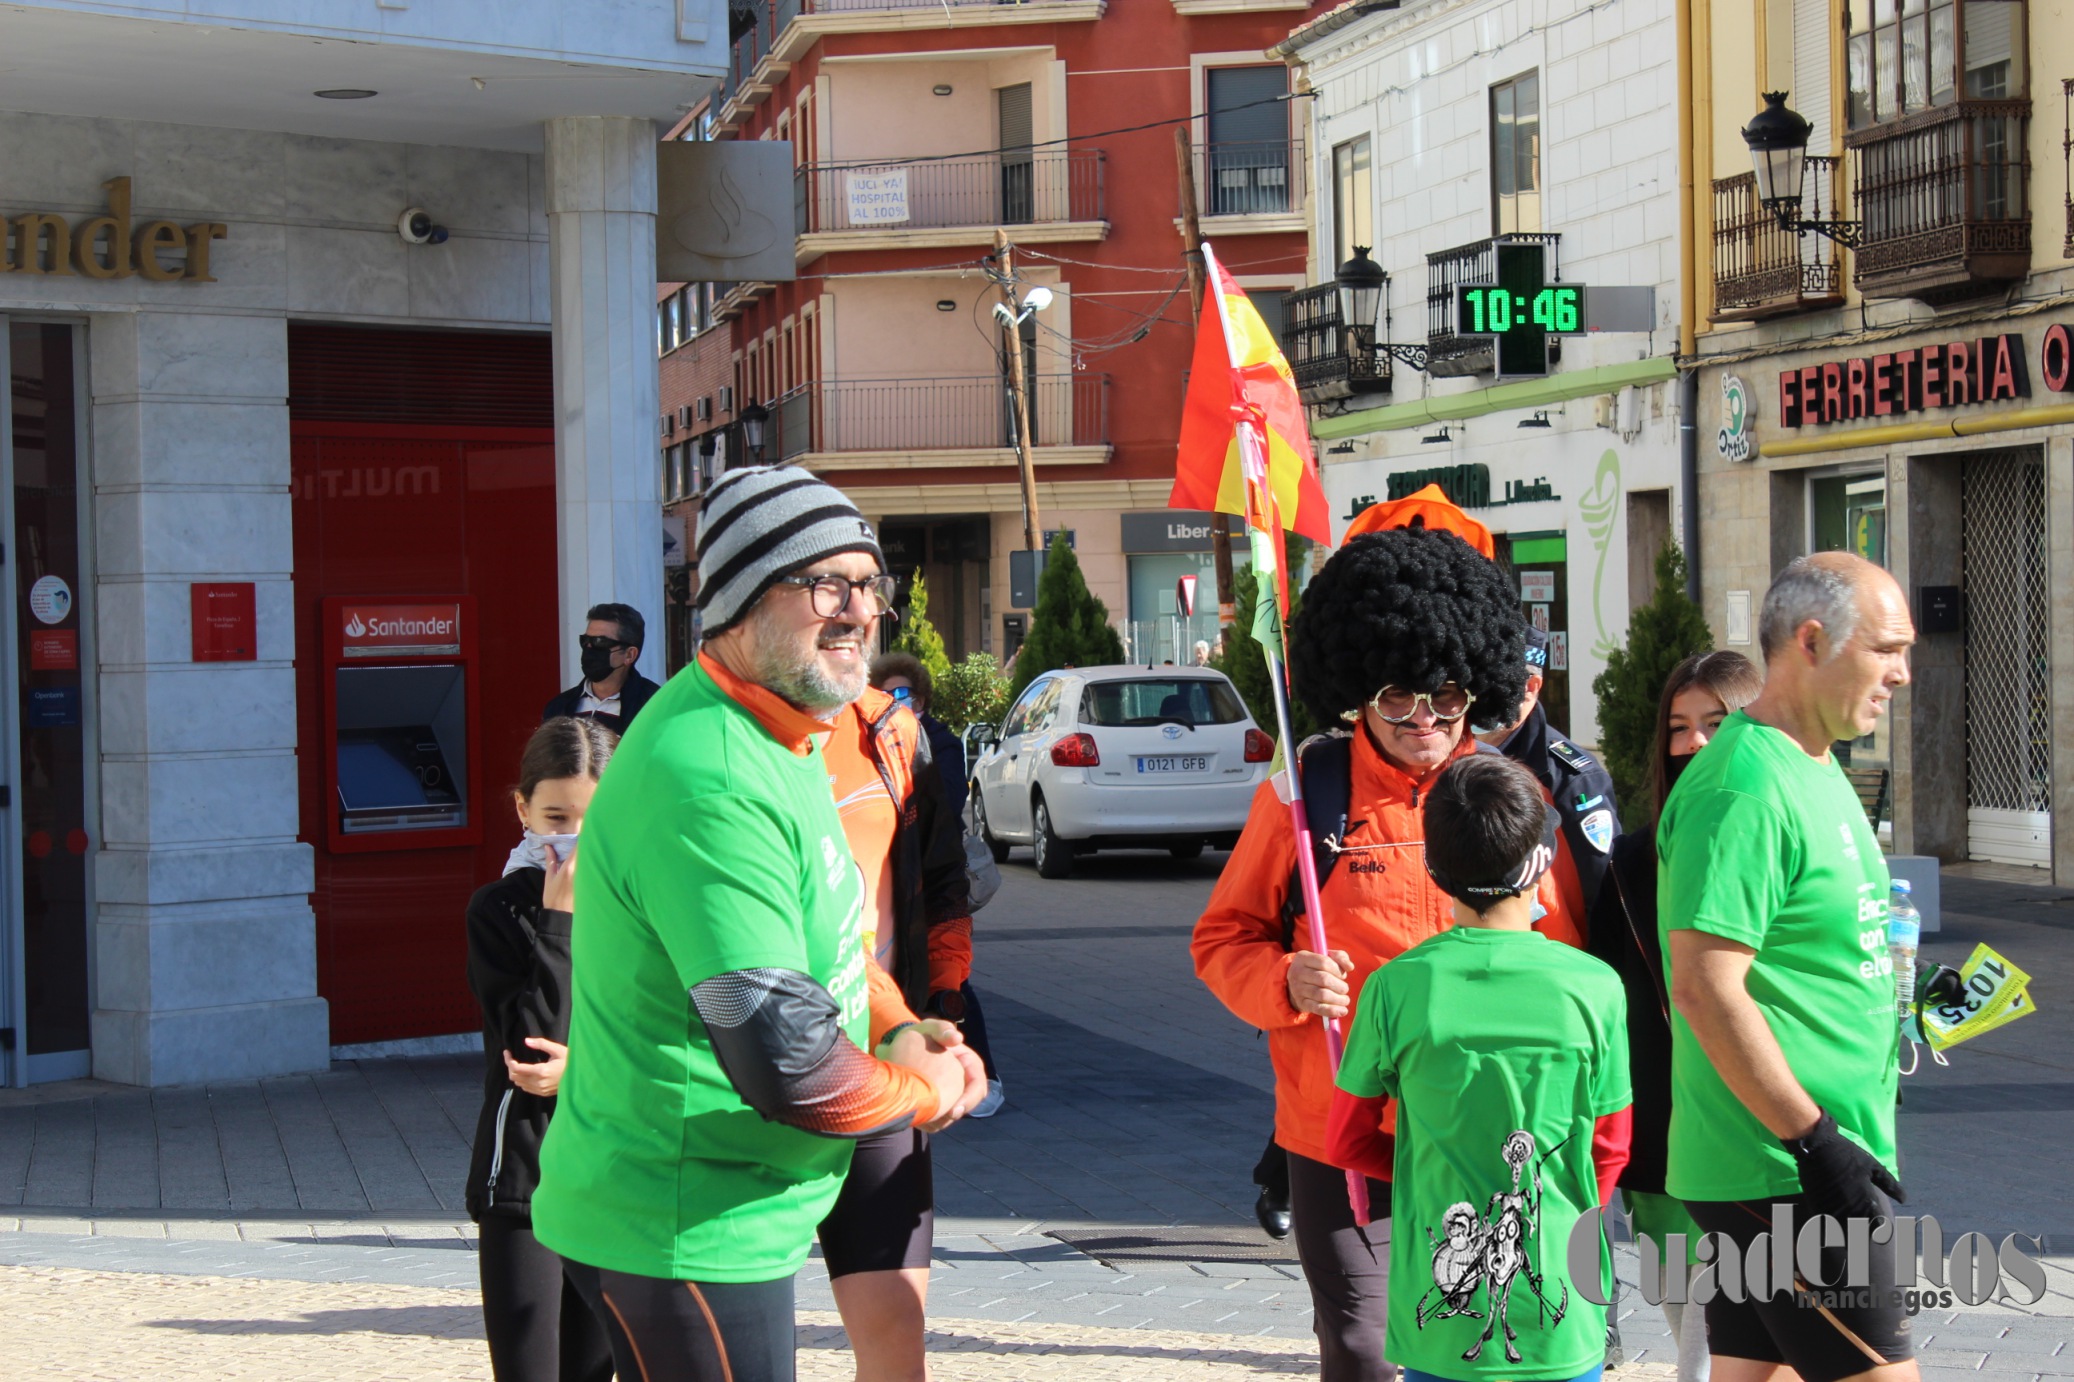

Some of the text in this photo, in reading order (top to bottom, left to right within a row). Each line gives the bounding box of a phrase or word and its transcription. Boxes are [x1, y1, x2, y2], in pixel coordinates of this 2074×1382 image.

[851, 192, 905, 204] HOSPITAL
[854, 206, 906, 218] AL 100%
[1466, 289, 1577, 332] 10:46
[1779, 334, 2018, 429] FERRETERIA
[368, 616, 453, 637] Santander
[34, 691, 65, 701] Openbank
[1147, 758, 1206, 771] 0121 GFB
[1349, 861, 1386, 874] Belló
[1937, 960, 2007, 1026] 1035
